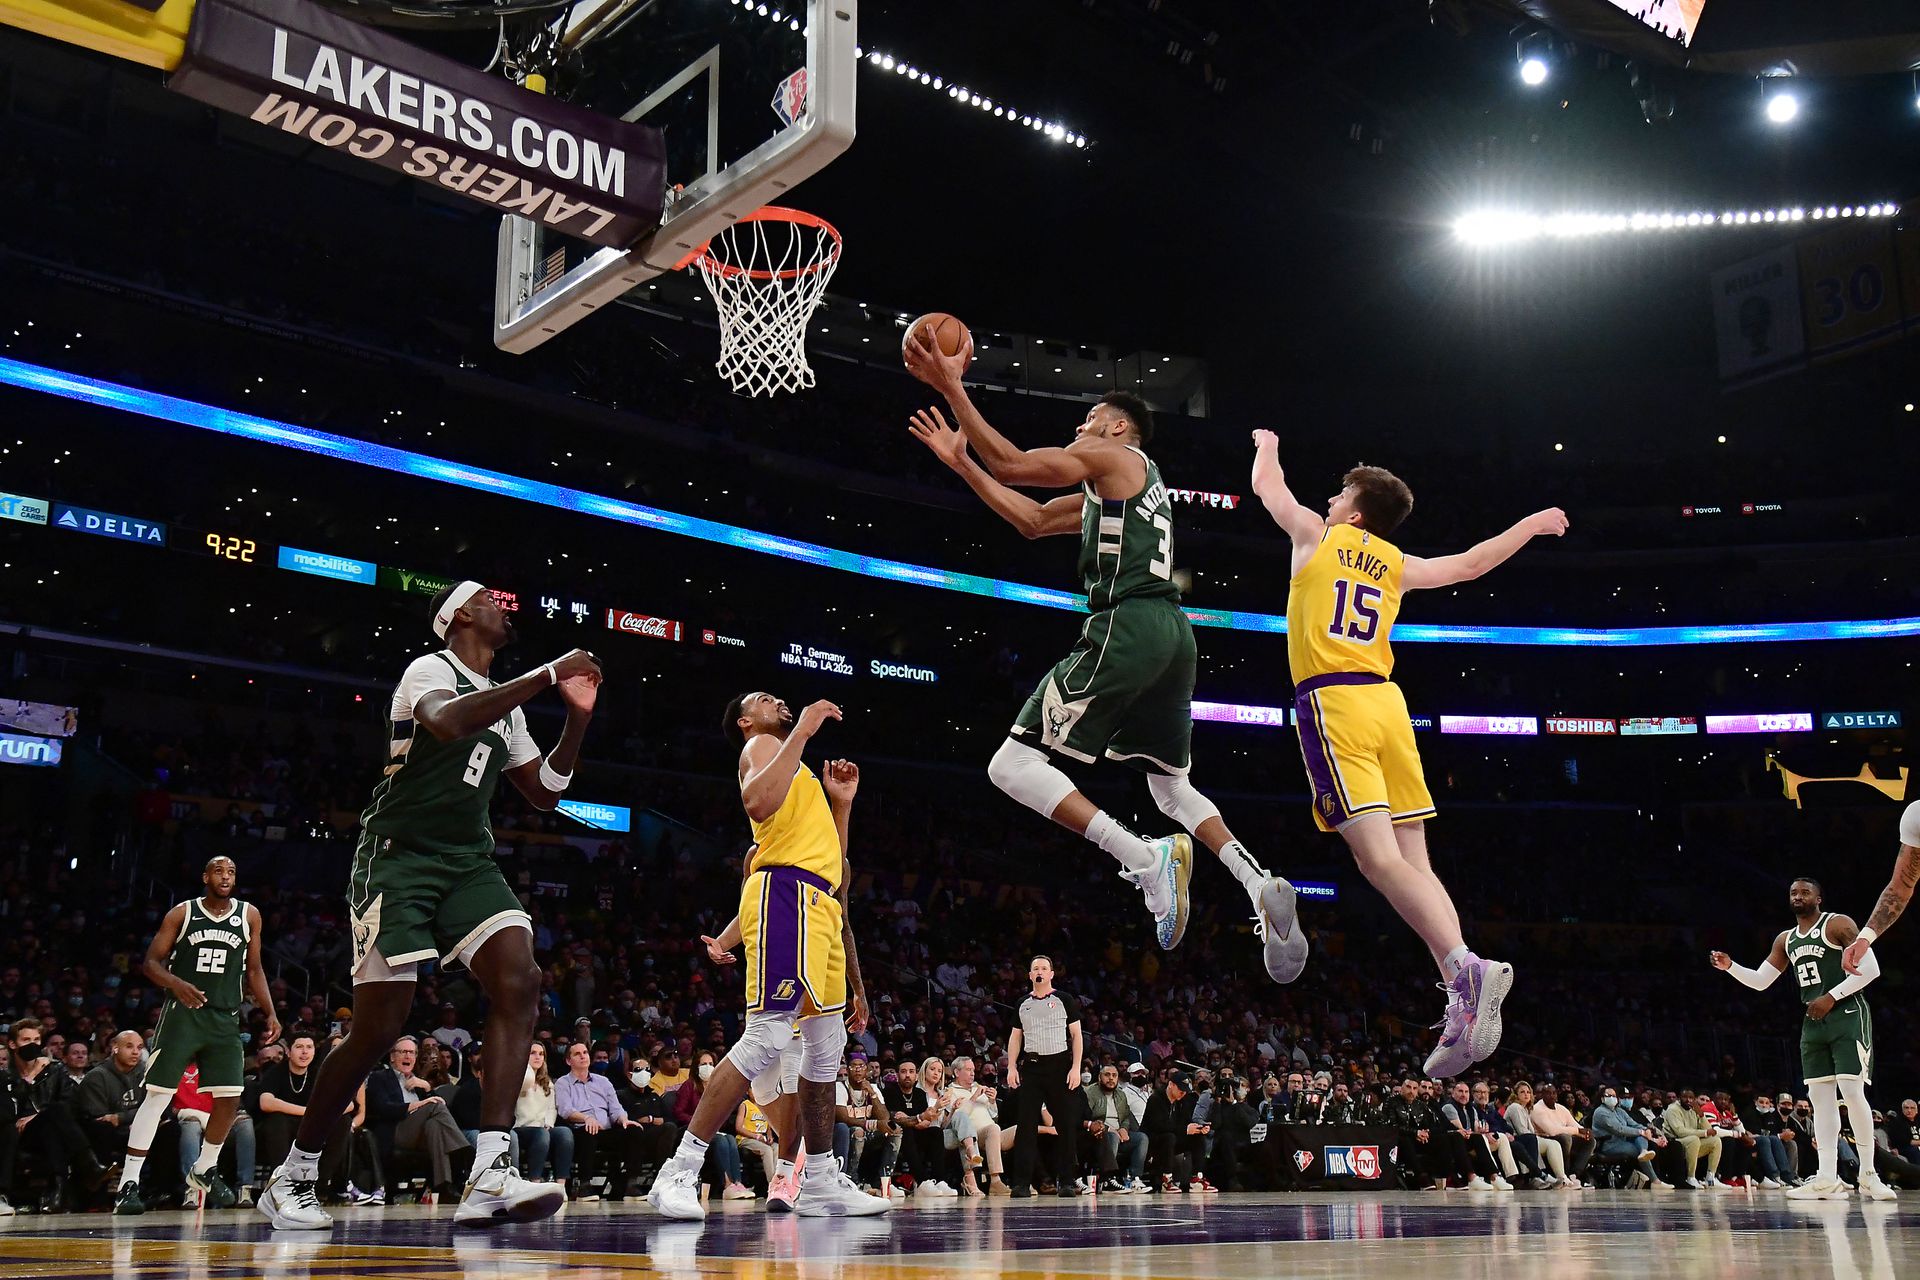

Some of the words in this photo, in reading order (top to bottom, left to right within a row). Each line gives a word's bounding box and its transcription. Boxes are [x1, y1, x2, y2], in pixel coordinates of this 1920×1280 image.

[271, 27, 626, 198] LAKERS.COM
[250, 92, 616, 238] LAKERS.COM
[1814, 263, 1884, 328] 30
[21, 505, 41, 514] ZERO
[1694, 507, 1722, 515] TOYOTA
[1755, 504, 1782, 512] TOYOTA
[85, 514, 162, 542] DELTA
[206, 533, 256, 563] 9:22
[293, 553, 363, 575] mobilitie
[1337, 548, 1388, 581] REAVES
[541, 596, 561, 610] LAL
[546, 608, 554, 619] 2
[571, 601, 590, 616] MIL
[1327, 579, 1383, 647] 15
[576, 613, 583, 624] 5
[716, 635, 746, 648] TOYOTA
[790, 643, 802, 655] TR
[808, 647, 846, 663] Germany
[781, 652, 802, 666] NBA
[820, 660, 832, 672] LA
[832, 662, 853, 676] 2022
[870, 659, 935, 682] Spectrum
[1546, 719, 1616, 733] TOSHIBA
[1843, 714, 1898, 727] DELTA
[462, 741, 493, 788] 9
[1302, 886, 1335, 895] EXPRESS
[187, 928, 242, 949] MILWAUKEE
[196, 947, 228, 974] 22
[1797, 960, 1822, 988] 23
[1328, 1153, 1348, 1174] NBA
[1357, 1159, 1376, 1172] TNT
